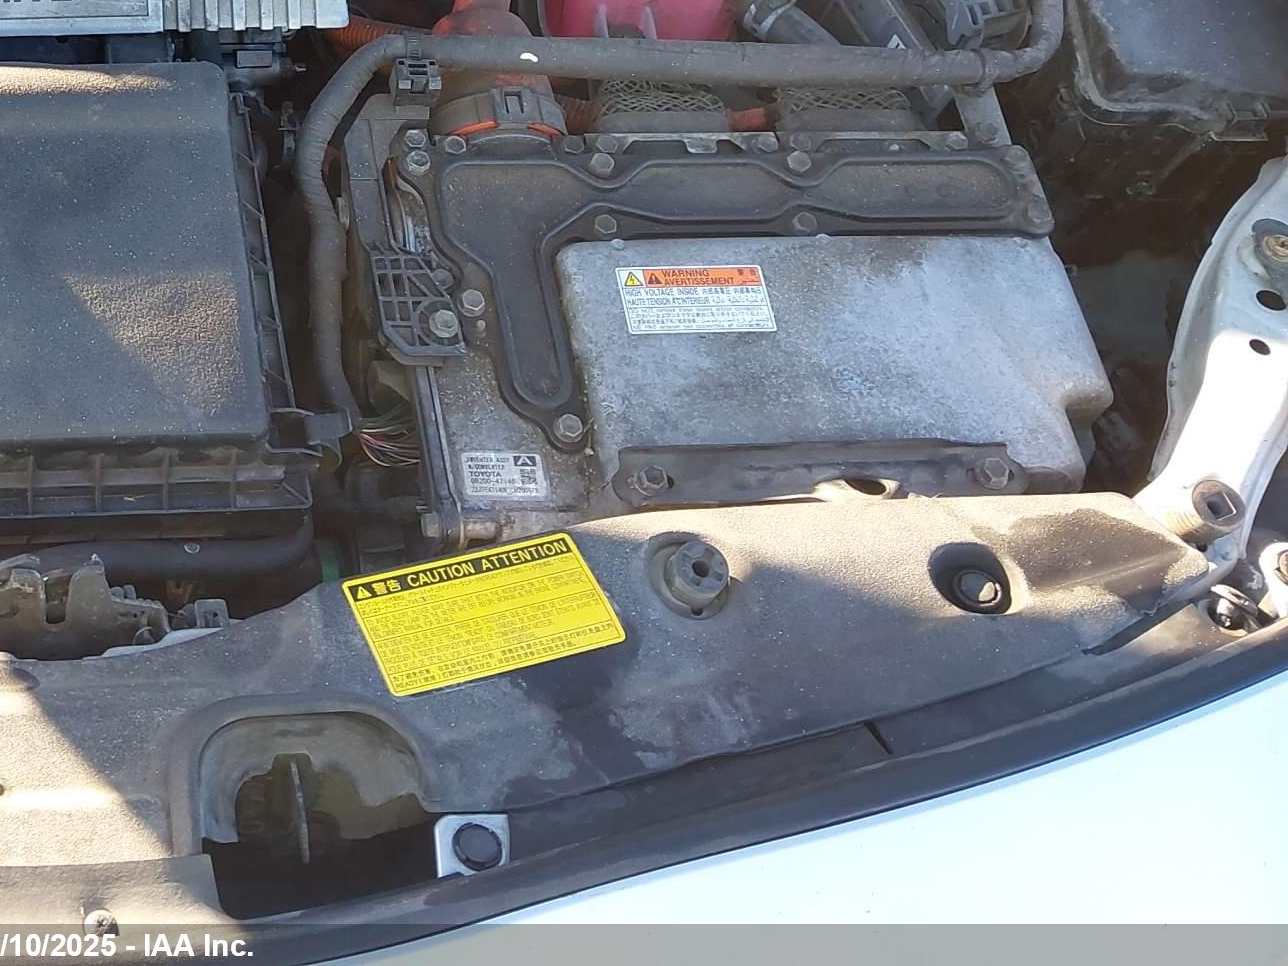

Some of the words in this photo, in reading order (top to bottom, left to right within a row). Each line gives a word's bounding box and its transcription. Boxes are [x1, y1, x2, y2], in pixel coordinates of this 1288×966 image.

[662, 269, 710, 277] WARNING
[664, 277, 734, 286] AVERTISSEMENT
[645, 288, 674, 296] VOLTAGE
[677, 287, 698, 295] INSIDE
[407, 561, 475, 587] CAUTION
[481, 540, 568, 571] ATTENTION
